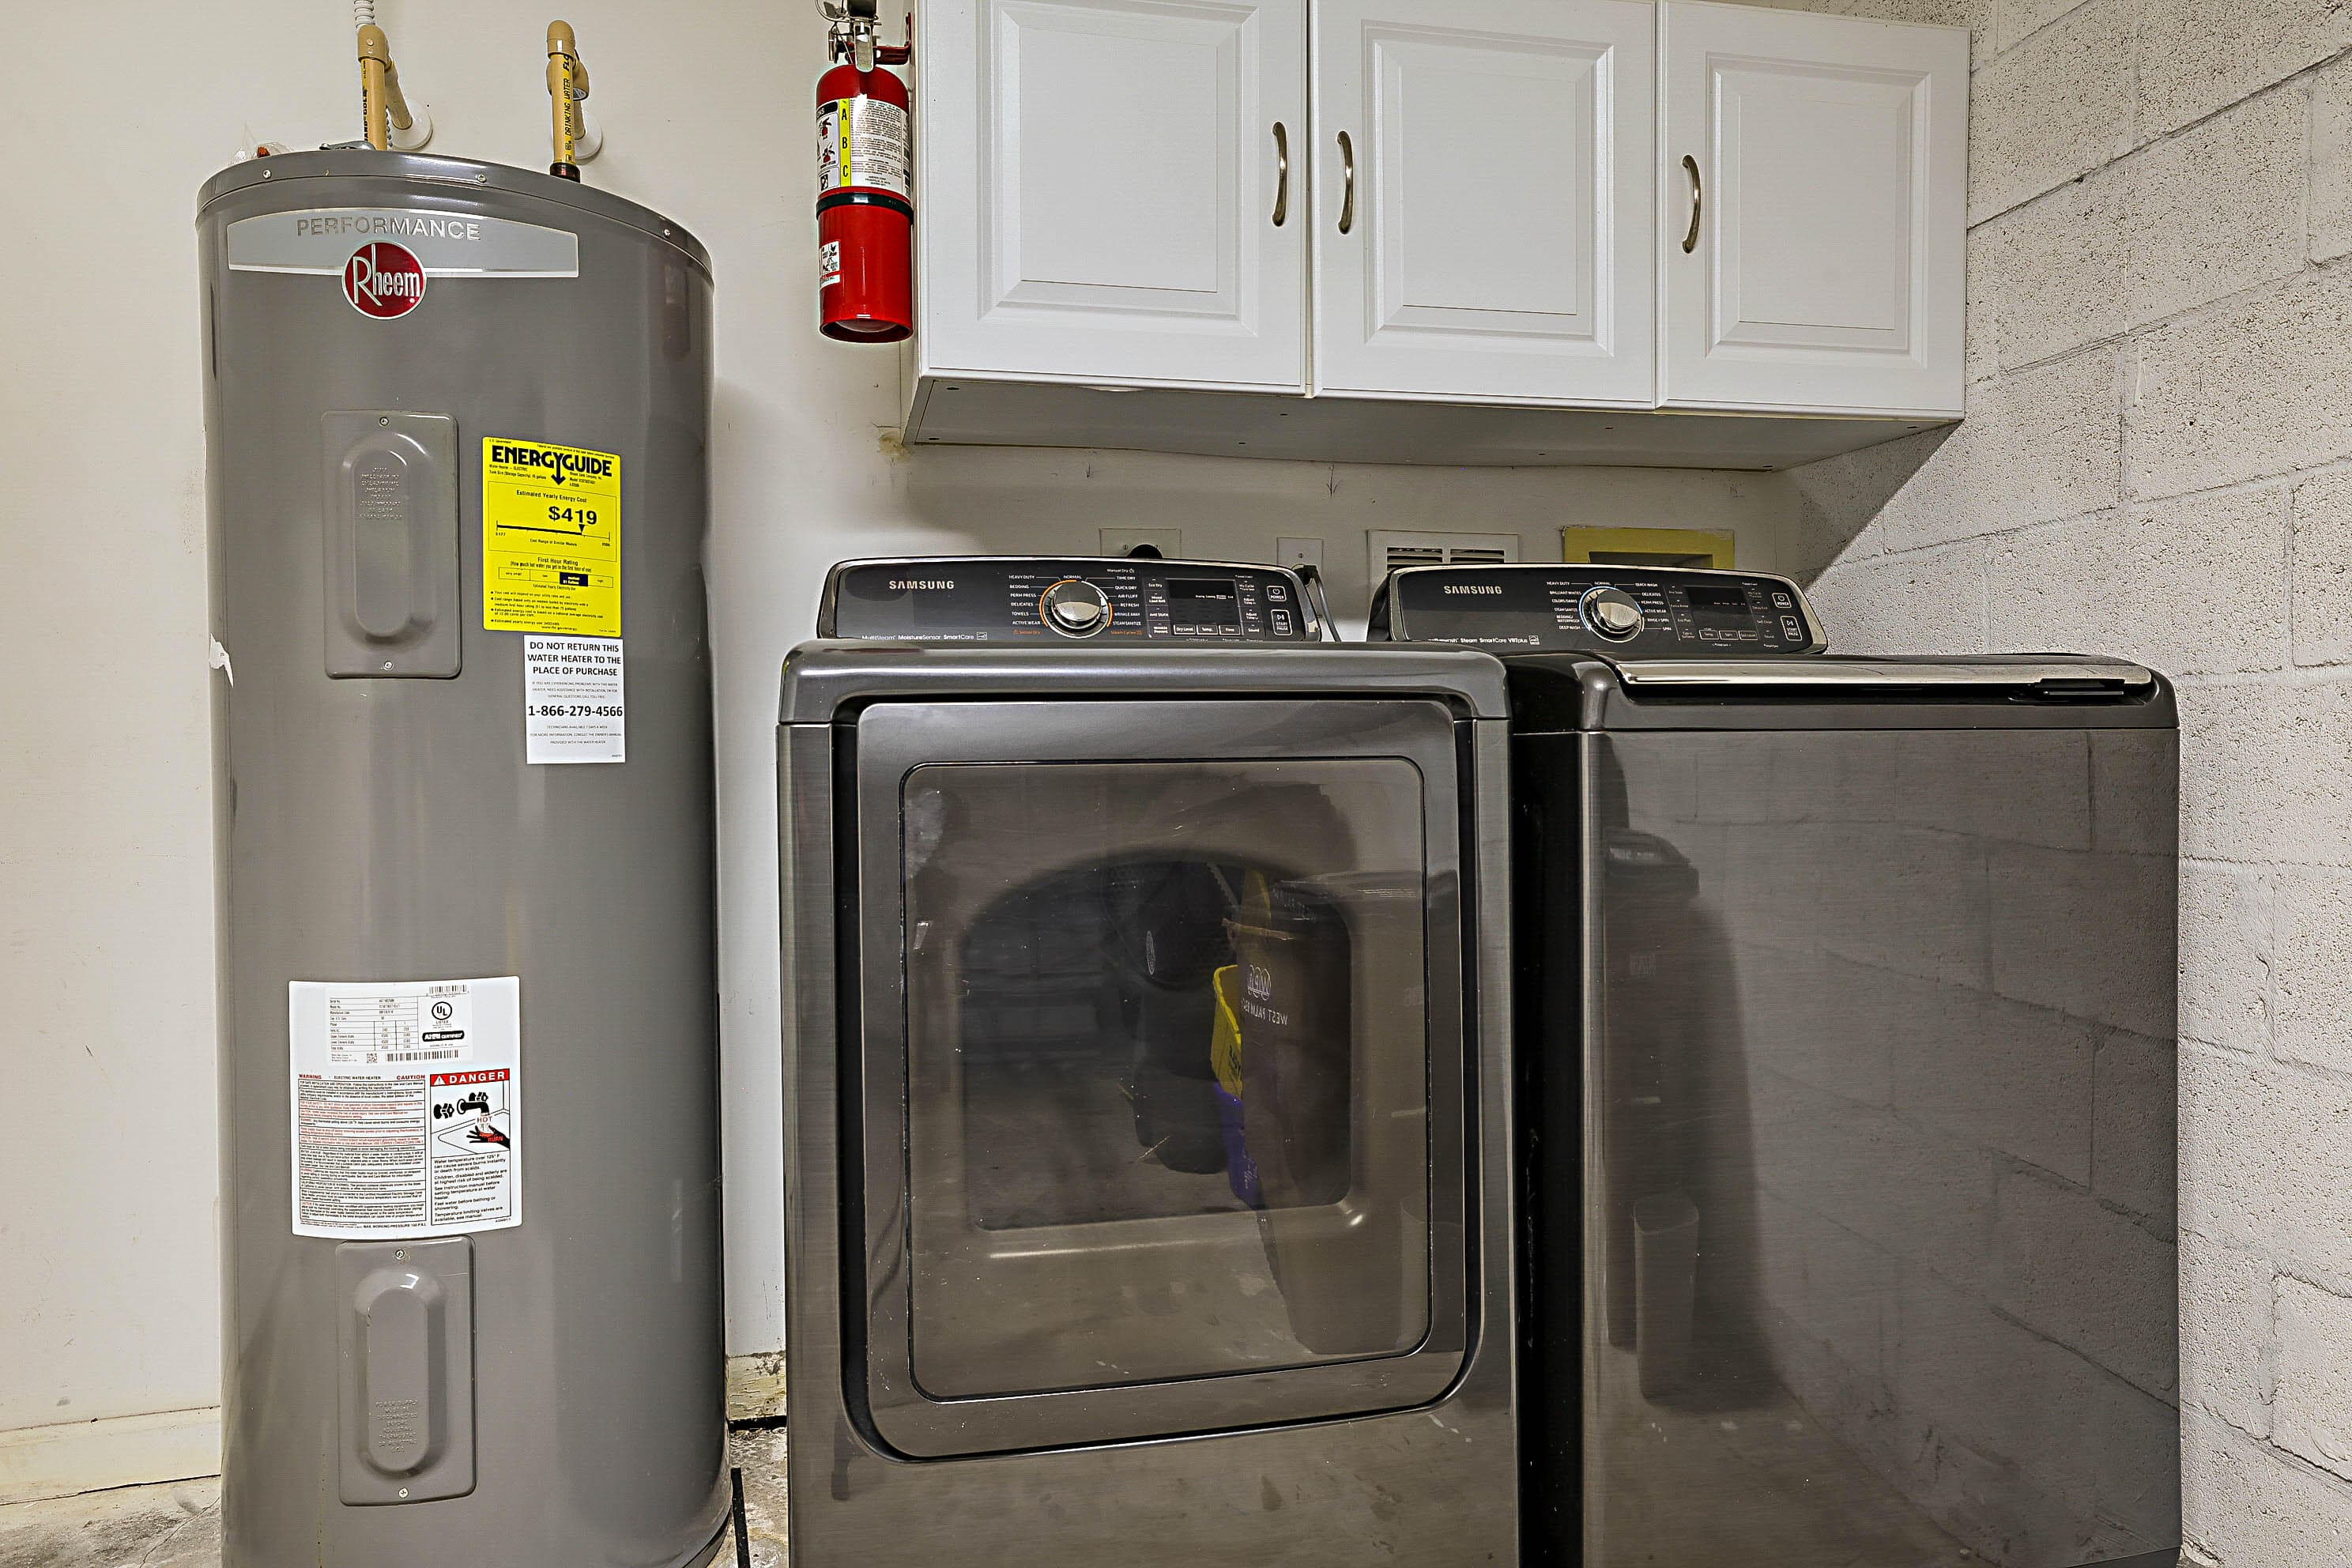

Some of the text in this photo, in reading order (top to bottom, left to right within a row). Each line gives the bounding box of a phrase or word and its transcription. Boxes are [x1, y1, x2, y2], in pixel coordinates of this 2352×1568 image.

[563, 77, 571, 100] WATER
[842, 108, 847, 120] A
[842, 137, 847, 149] B
[842, 165, 848, 177] C
[296, 216, 481, 241] PERFORMANCE
[352, 243, 420, 306] Rheem
[492, 445, 612, 477] ENERGYGUIDE
[560, 494, 575, 503] Energy
[548, 506, 597, 525] $419
[889, 580, 955, 590] SAMSUNG
[1443, 585, 1502, 594] SAMSUNG
[567, 643, 600, 651] RETURN
[528, 706, 623, 716] 1-866-279-4566
[437, 1006, 447, 1016] UL
[449, 1071, 505, 1084] DANGER
